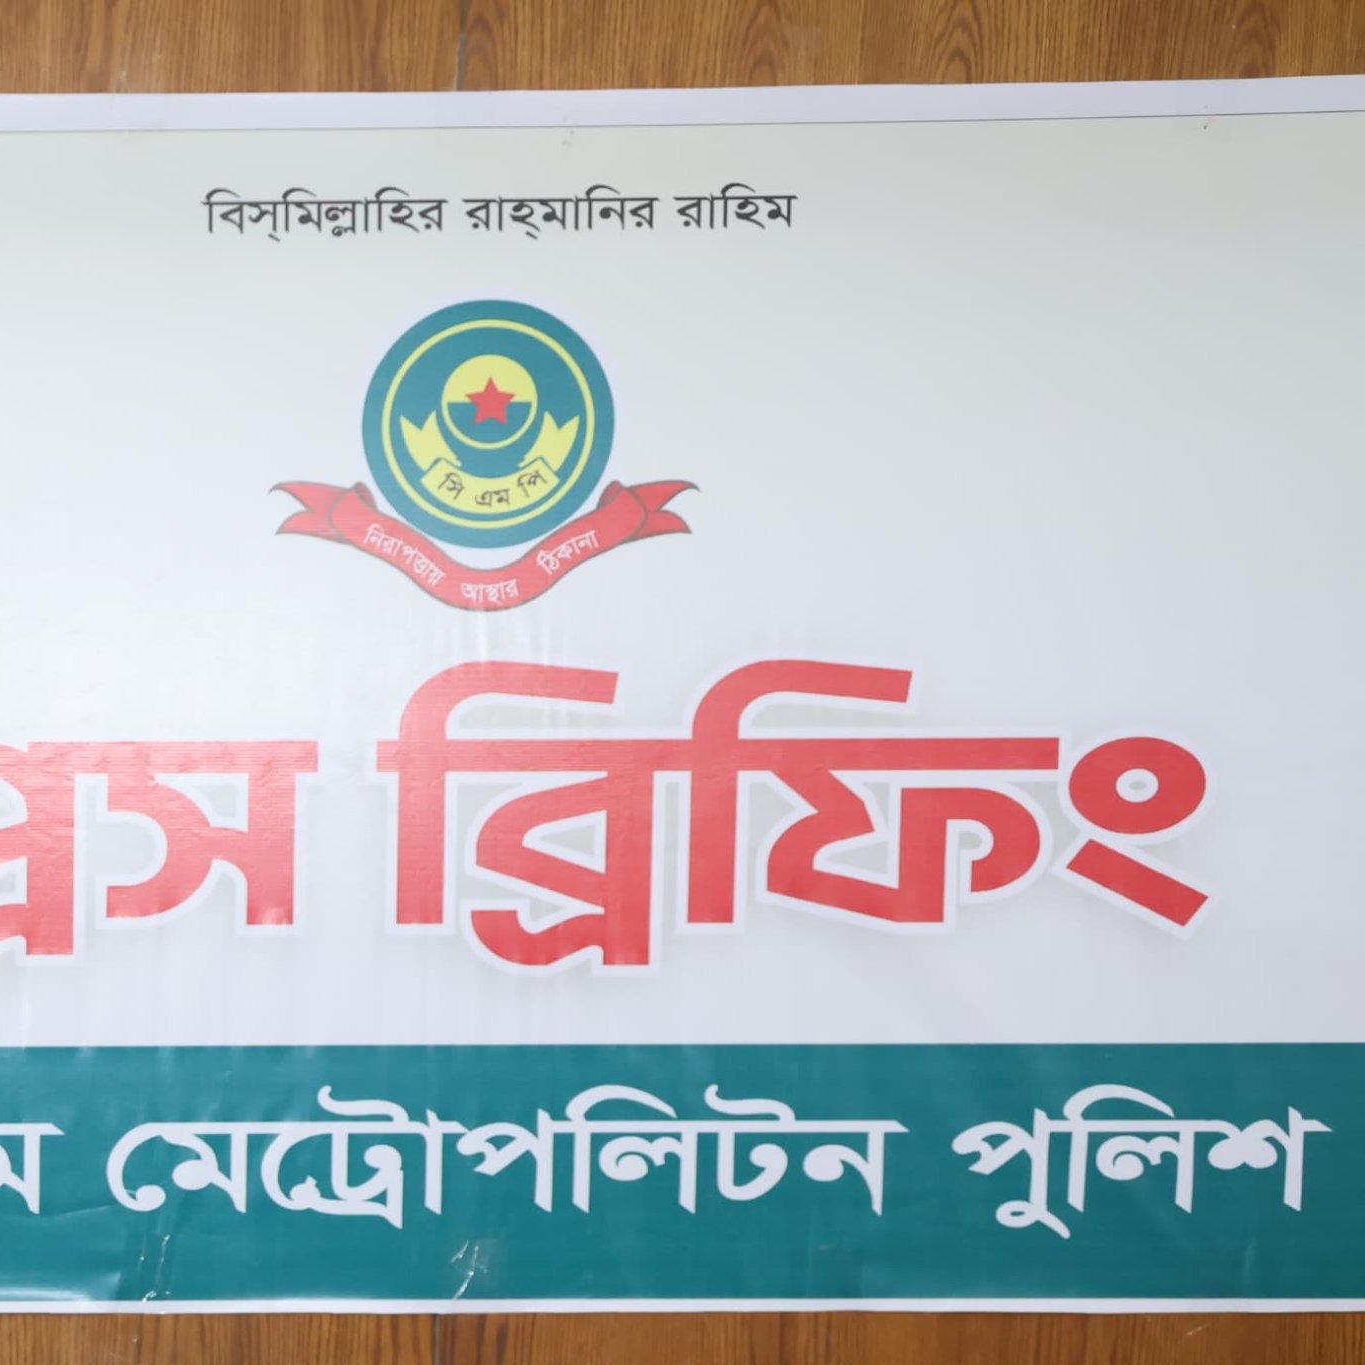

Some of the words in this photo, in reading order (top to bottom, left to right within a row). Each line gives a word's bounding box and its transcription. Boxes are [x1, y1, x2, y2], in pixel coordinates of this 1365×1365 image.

[673, 183, 797, 231] রাহিম
[438, 472, 466, 499] সি
[475, 487, 511, 508] এম
[517, 469, 548, 498] পি
[536, 529, 600, 577] ঠিকানা
[376, 659, 1211, 967] ব্রিফিং
[105, 1084, 910, 1229] মেট্রোপলিটন
[952, 1083, 1333, 1239] পুলিশ
